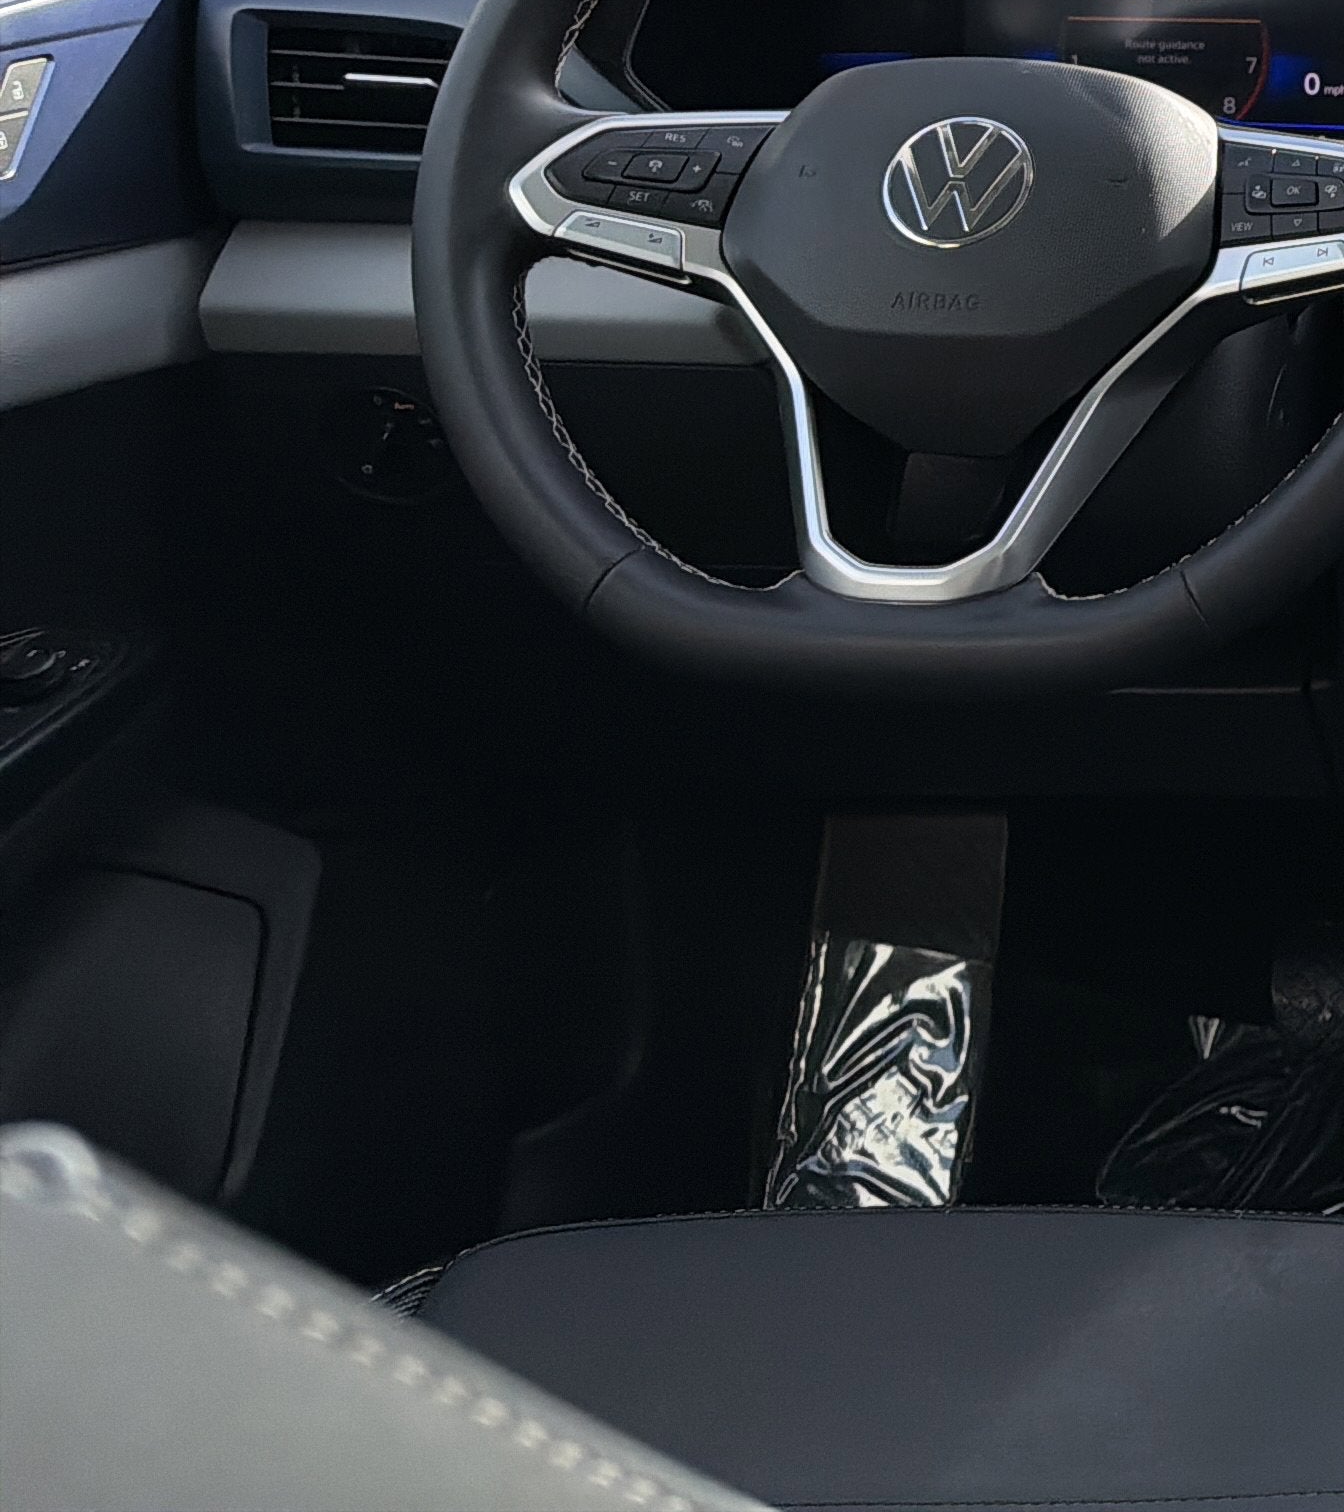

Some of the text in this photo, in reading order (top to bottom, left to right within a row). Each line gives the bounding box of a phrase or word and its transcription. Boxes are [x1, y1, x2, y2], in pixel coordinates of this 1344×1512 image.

[1158, 38, 1205, 54] guidance
[1137, 53, 1155, 65] not
[1246, 57, 1258, 74] 7
[1303, 72, 1321, 95] 0
[1223, 97, 1236, 115] 8
[664, 132, 686, 143] RES
[629, 190, 649, 202] SET
[1285, 185, 1302, 196] OK
[1230, 219, 1254, 231] VIEW
[890, 292, 981, 313] AIRBAG
